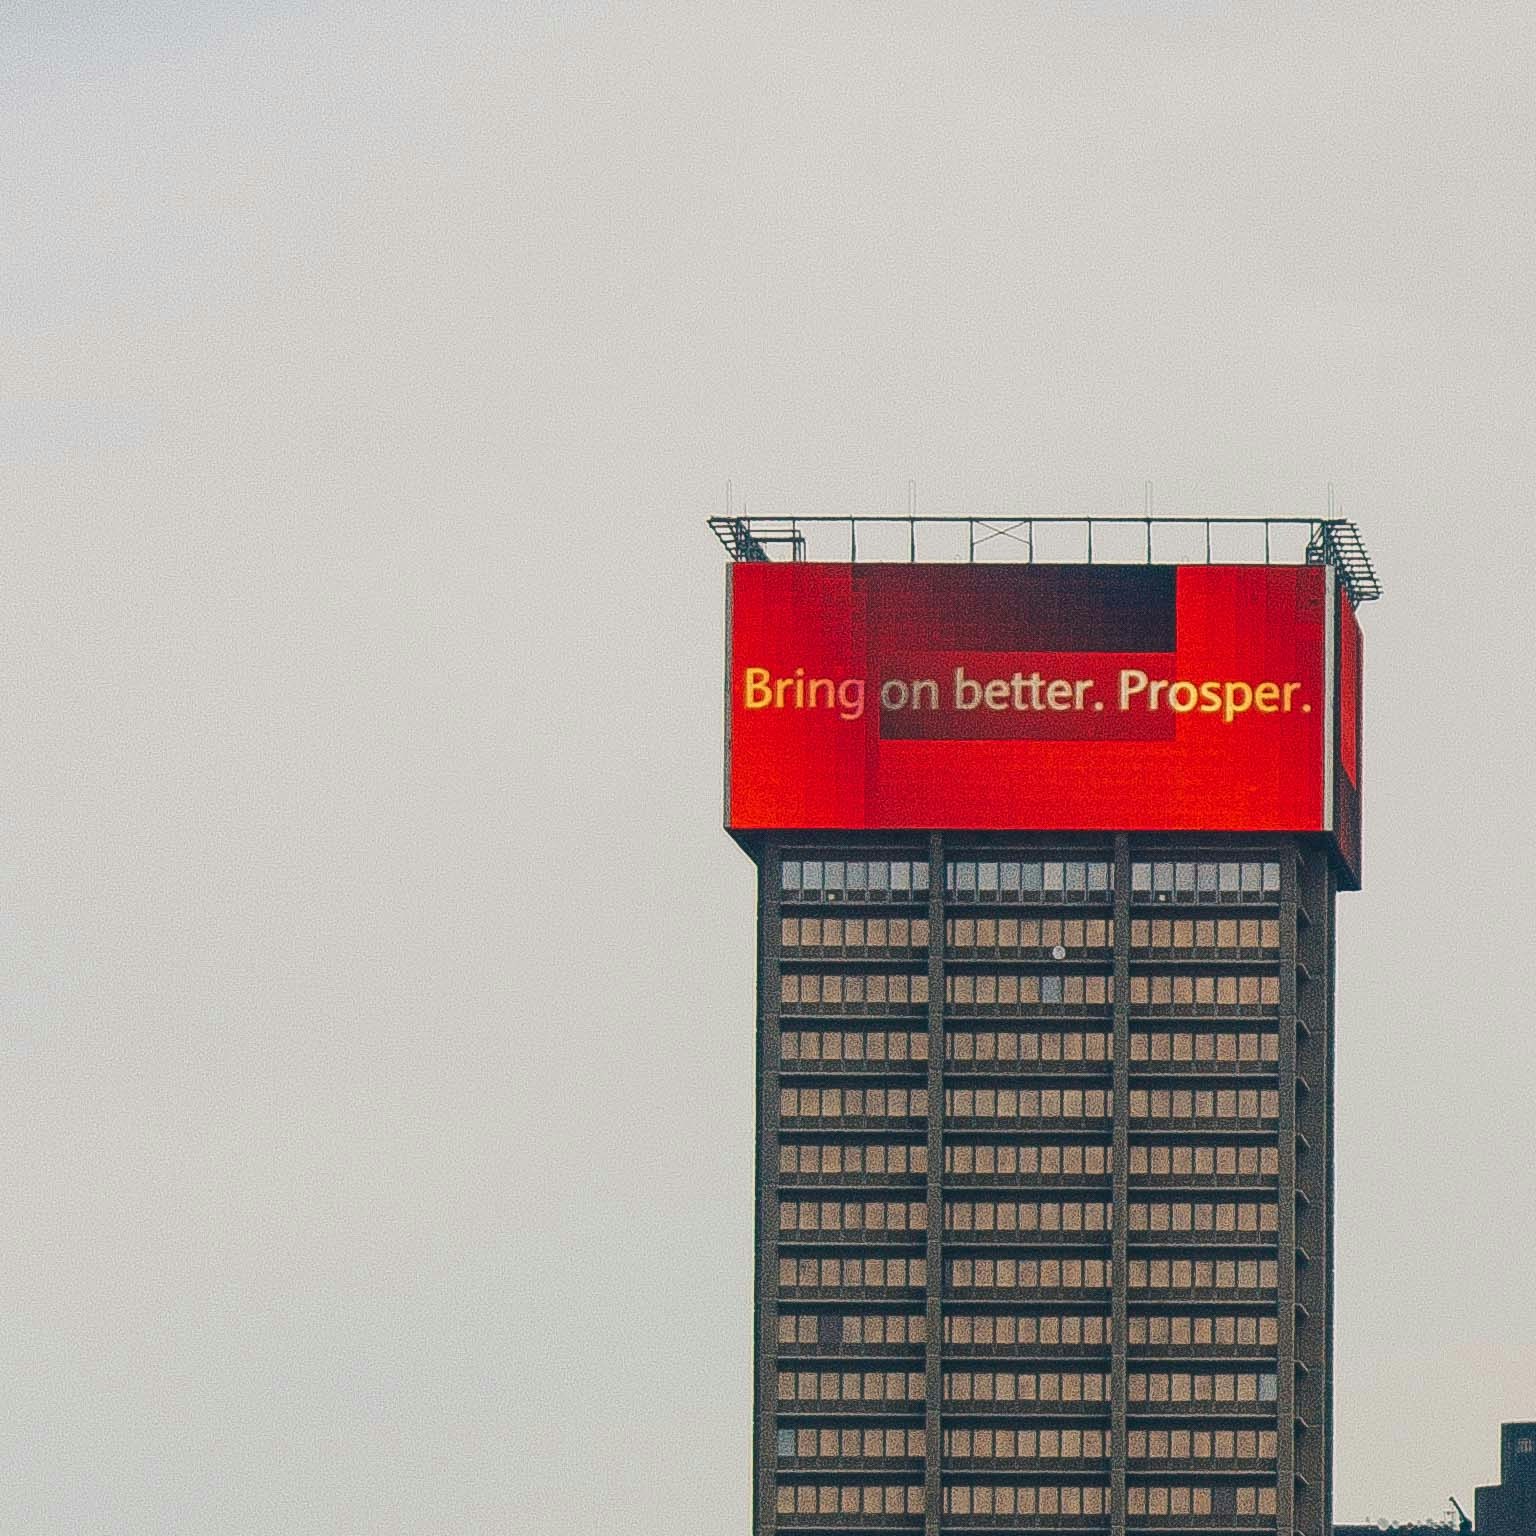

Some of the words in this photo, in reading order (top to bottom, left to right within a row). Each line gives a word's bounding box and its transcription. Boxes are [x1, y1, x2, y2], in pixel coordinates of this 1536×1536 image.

[744, 668, 866, 721] Bring
[880, 678, 941, 711] on
[953, 668, 1104, 712] better.
[1118, 669, 1312, 721] Prosper.
